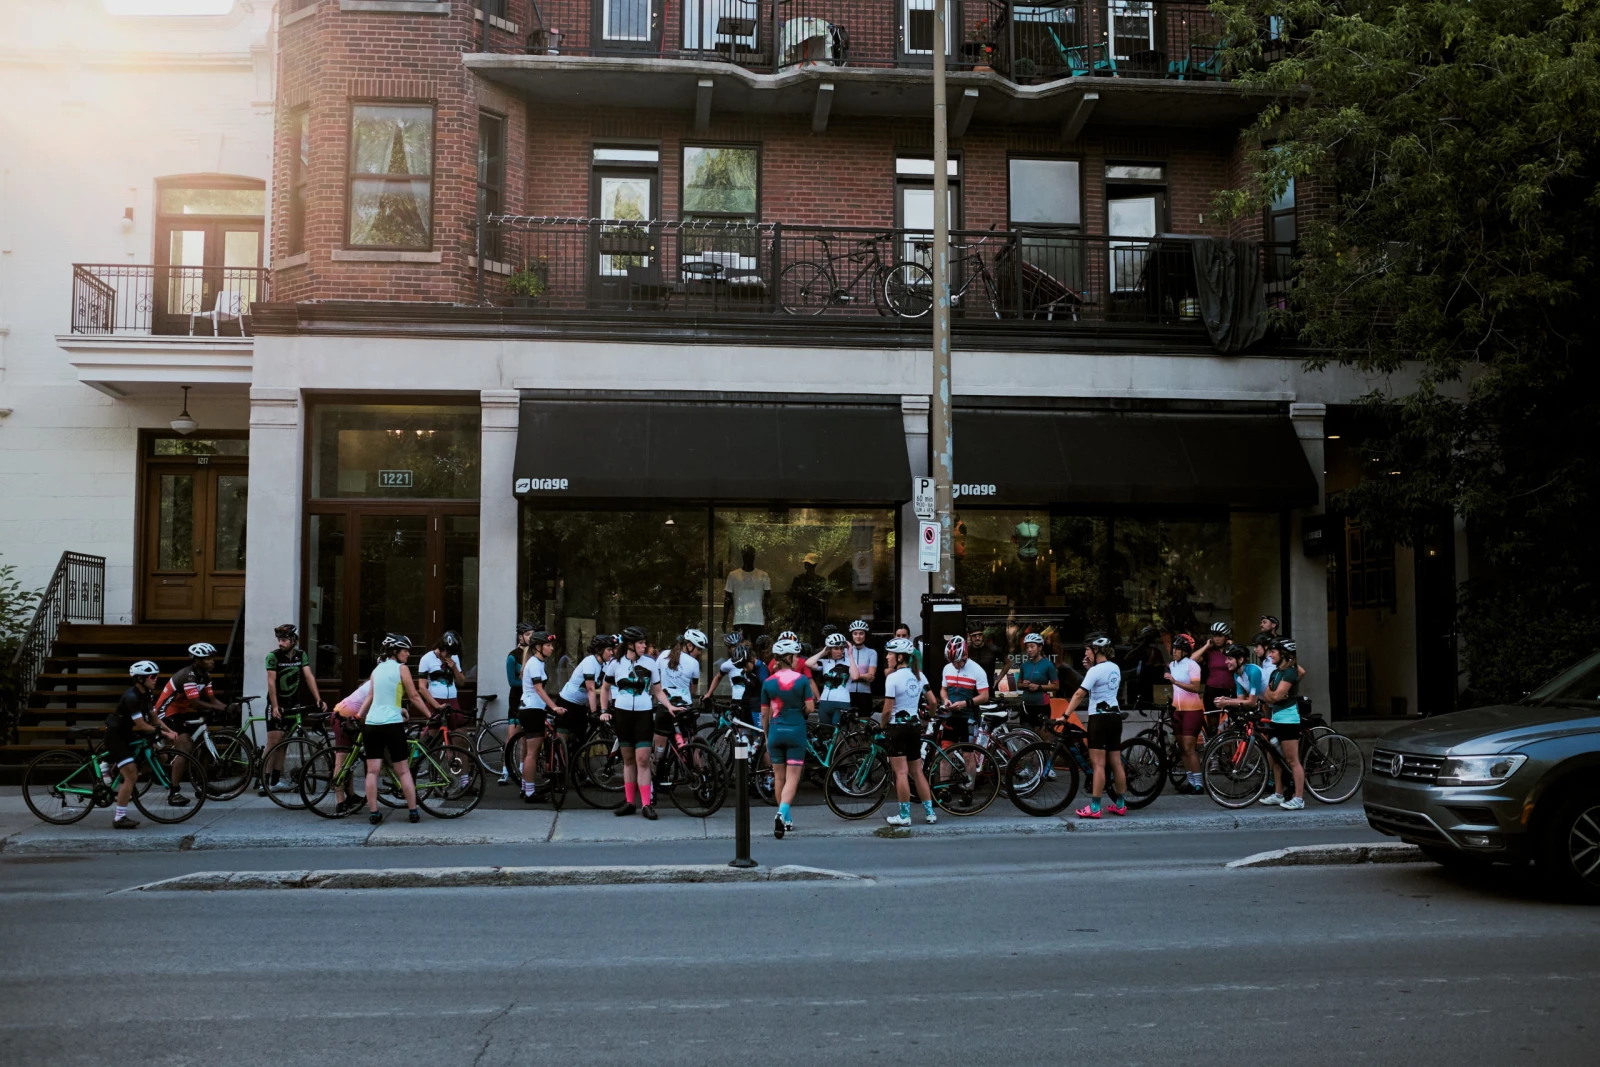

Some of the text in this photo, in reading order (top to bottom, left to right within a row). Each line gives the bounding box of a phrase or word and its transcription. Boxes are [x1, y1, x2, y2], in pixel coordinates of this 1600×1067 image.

[197, 457, 209, 465] 1217
[383, 473, 409, 484] 1221
[531, 478, 569, 490] orage
[921, 479, 929, 494] P
[960, 483, 997, 496] orage
